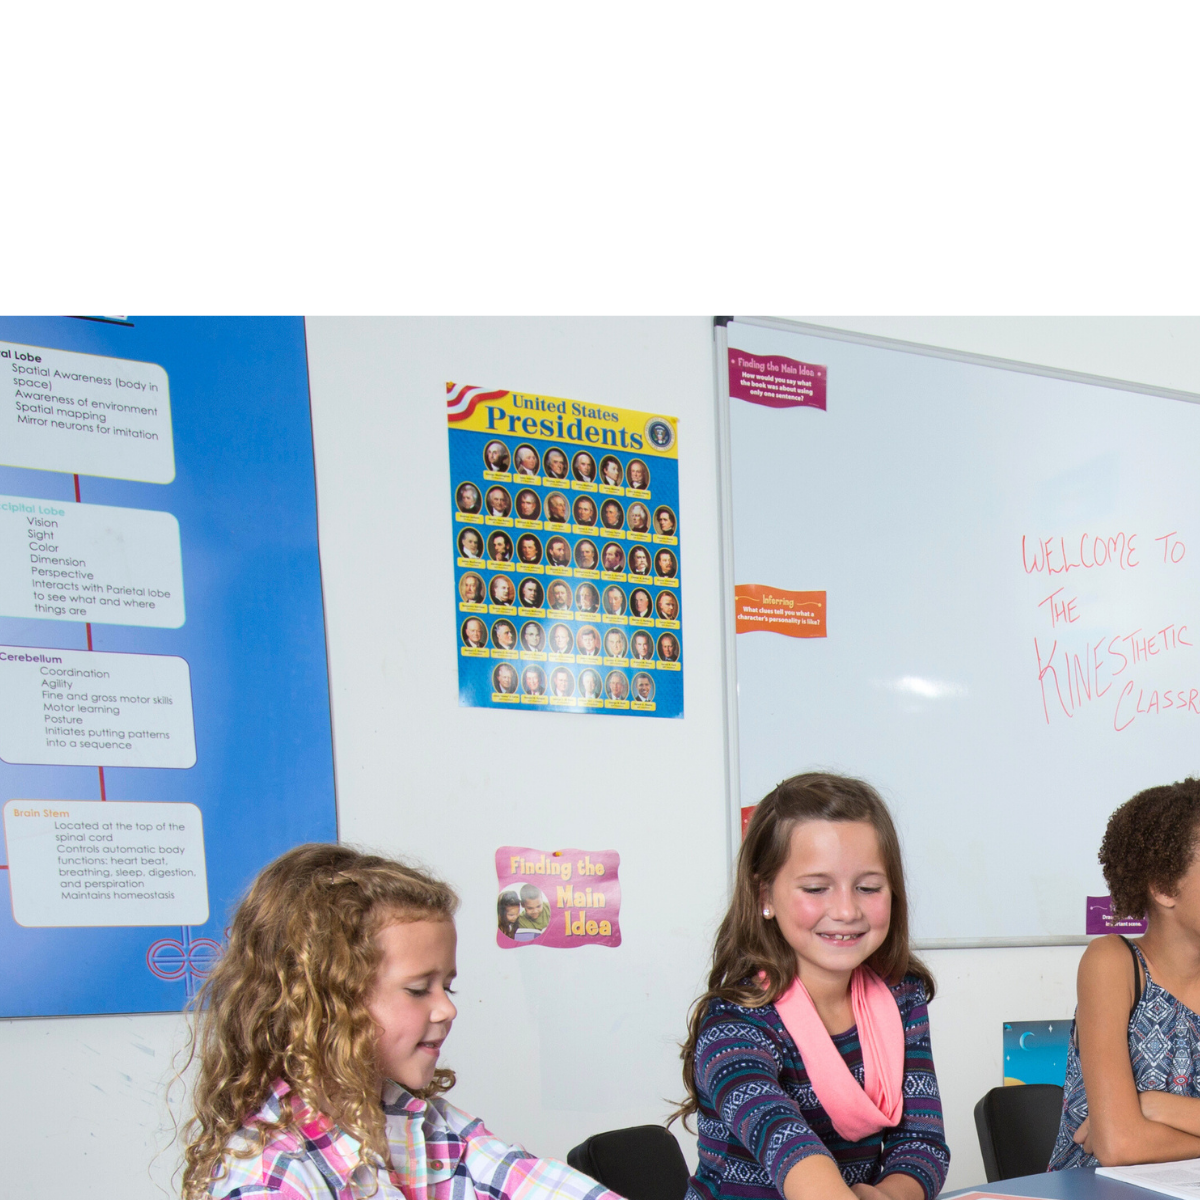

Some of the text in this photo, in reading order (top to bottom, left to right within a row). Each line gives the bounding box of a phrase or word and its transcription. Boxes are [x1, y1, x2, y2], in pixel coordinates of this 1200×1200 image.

[15, 351, 42, 363] Lobe
[738, 358, 814, 376] Finding the Main Idea
[12, 363, 158, 391] Spatial Awareness (body in
[14, 377, 52, 391] space)
[780, 384, 796, 392] about
[797, 388, 813, 396] using
[776, 392, 804, 401] sentence?
[15, 390, 158, 416] Awareness of environment
[512, 394, 619, 422] United States
[16, 402, 106, 423] Spatial mapping
[18, 415, 158, 440] Mirror neurons for imitation
[485, 405, 643, 450] Presidents
[0, 503, 65, 516] cipital Lobe
[27, 517, 58, 528] Vision
[28, 529, 54, 540] Sight
[29, 542, 58, 552] Color
[1023, 531, 1185, 575] WELCOME TO
[31, 554, 86, 567] Dimension
[32, 567, 94, 580] Perspective
[32, 580, 170, 598] Interacts with Parietal lobe
[33, 591, 155, 609] to see what and where
[762, 594, 794, 608] Inferring
[35, 604, 86, 615] things are
[1038, 587, 1080, 628] THE
[769, 616, 800, 625] personality
[0, 653, 62, 663] Cerebellum
[40, 667, 110, 678] Coordination
[1034, 624, 1193, 724] KINESTHETIC
[41, 679, 73, 689] Agility
[42, 691, 63, 699] Fine
[91, 695, 117, 703] gross
[120, 695, 150, 703] motor
[153, 696, 173, 704] skills
[44, 704, 120, 715] Motor learning
[45, 715, 83, 724] Posture
[45, 727, 170, 739] Initiates putting patterns
[47, 738, 66, 747] into
[80, 741, 132, 749] sequence
[14, 809, 69, 817] Brain Stem
[55, 822, 99, 830] Located
[116, 822, 132, 830] the
[136, 823, 153, 833] top
[156, 822, 166, 831] of
[169, 823, 185, 831] the
[56, 833, 113, 843] spinal cord
[57, 845, 185, 855] Controls automatic body
[58, 857, 108, 865] functions:
[111, 857, 137, 865] heart
[149, 868, 196, 878] digestion,
[510, 854, 605, 881] Finding the
[84, 880, 144, 890] perspiration
[61, 891, 175, 899] Maintains homeostasis
[556, 885, 605, 908] Main
[565, 911, 612, 936] Idea
